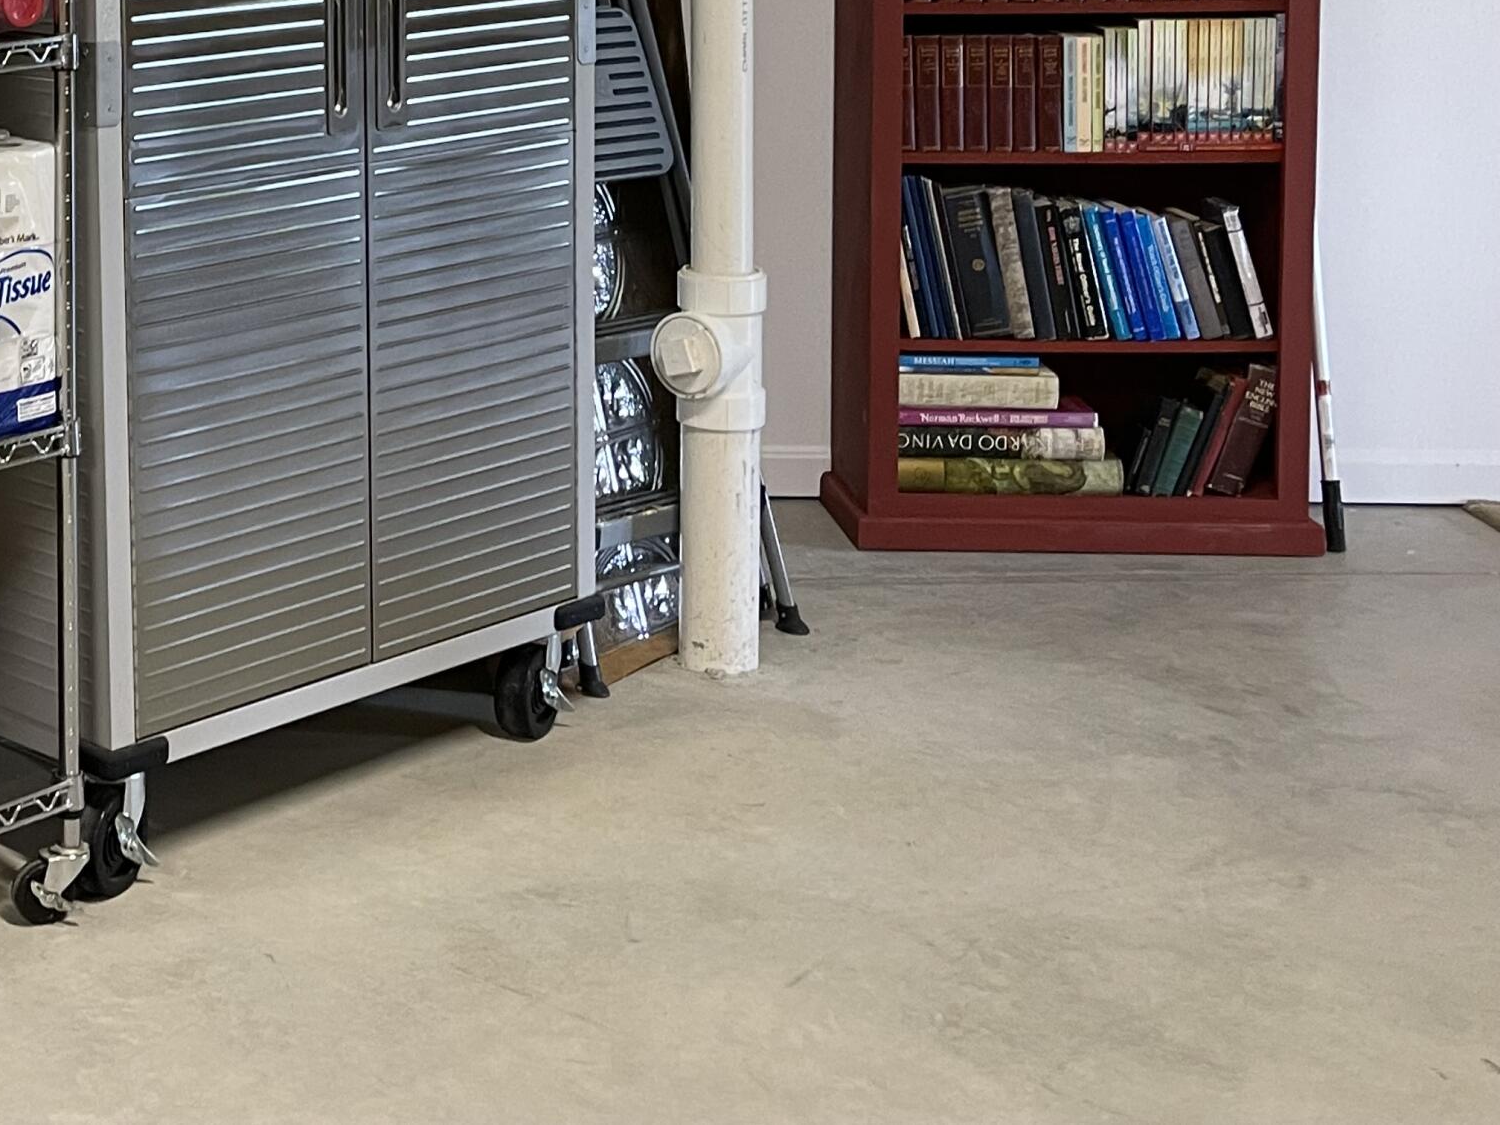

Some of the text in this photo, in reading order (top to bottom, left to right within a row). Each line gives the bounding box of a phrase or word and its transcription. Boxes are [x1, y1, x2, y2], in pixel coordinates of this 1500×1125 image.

[16, 232, 38, 243] Mark
[913, 356, 955, 366] MESSIAH
[1260, 379, 1276, 390] THE
[1255, 386, 1276, 398] NEW
[920, 412, 958, 424] Norman
[959, 412, 1000, 424] Rockwell
[899, 433, 945, 451] VINC
